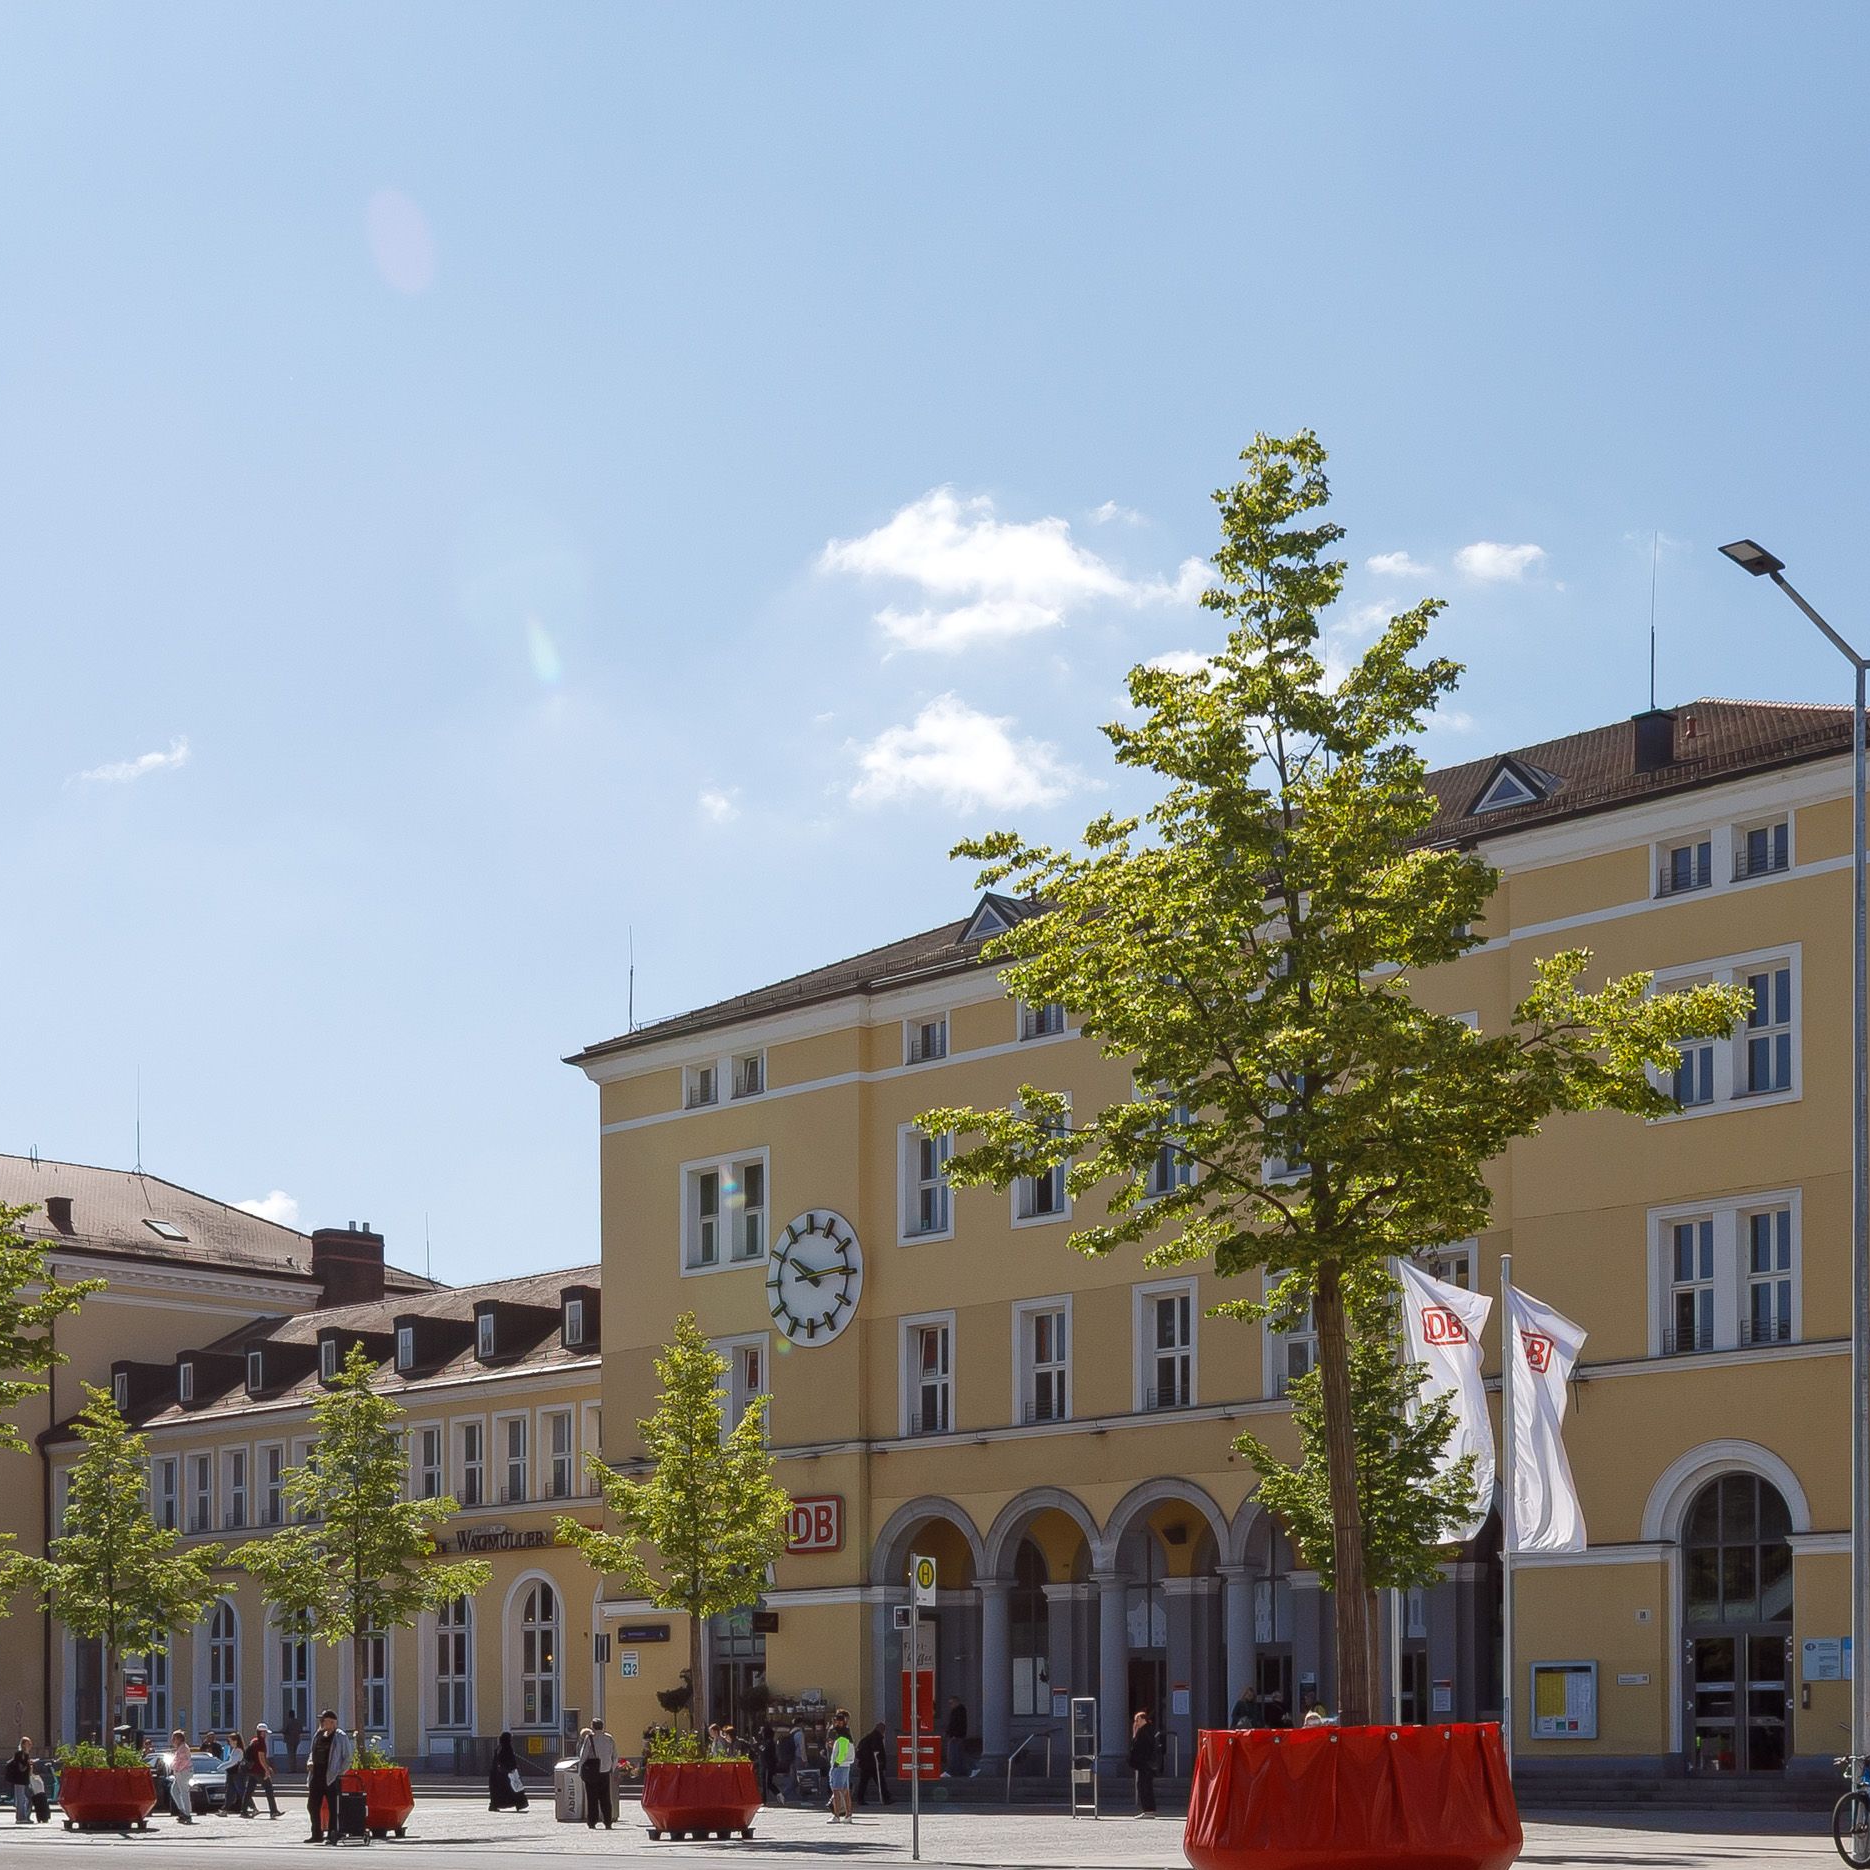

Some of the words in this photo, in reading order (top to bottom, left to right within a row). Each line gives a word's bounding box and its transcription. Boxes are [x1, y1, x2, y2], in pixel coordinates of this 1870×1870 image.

[1428, 1312, 1463, 1340] DB
[793, 1505, 834, 1545] DB
[922, 1565, 930, 1585] H
